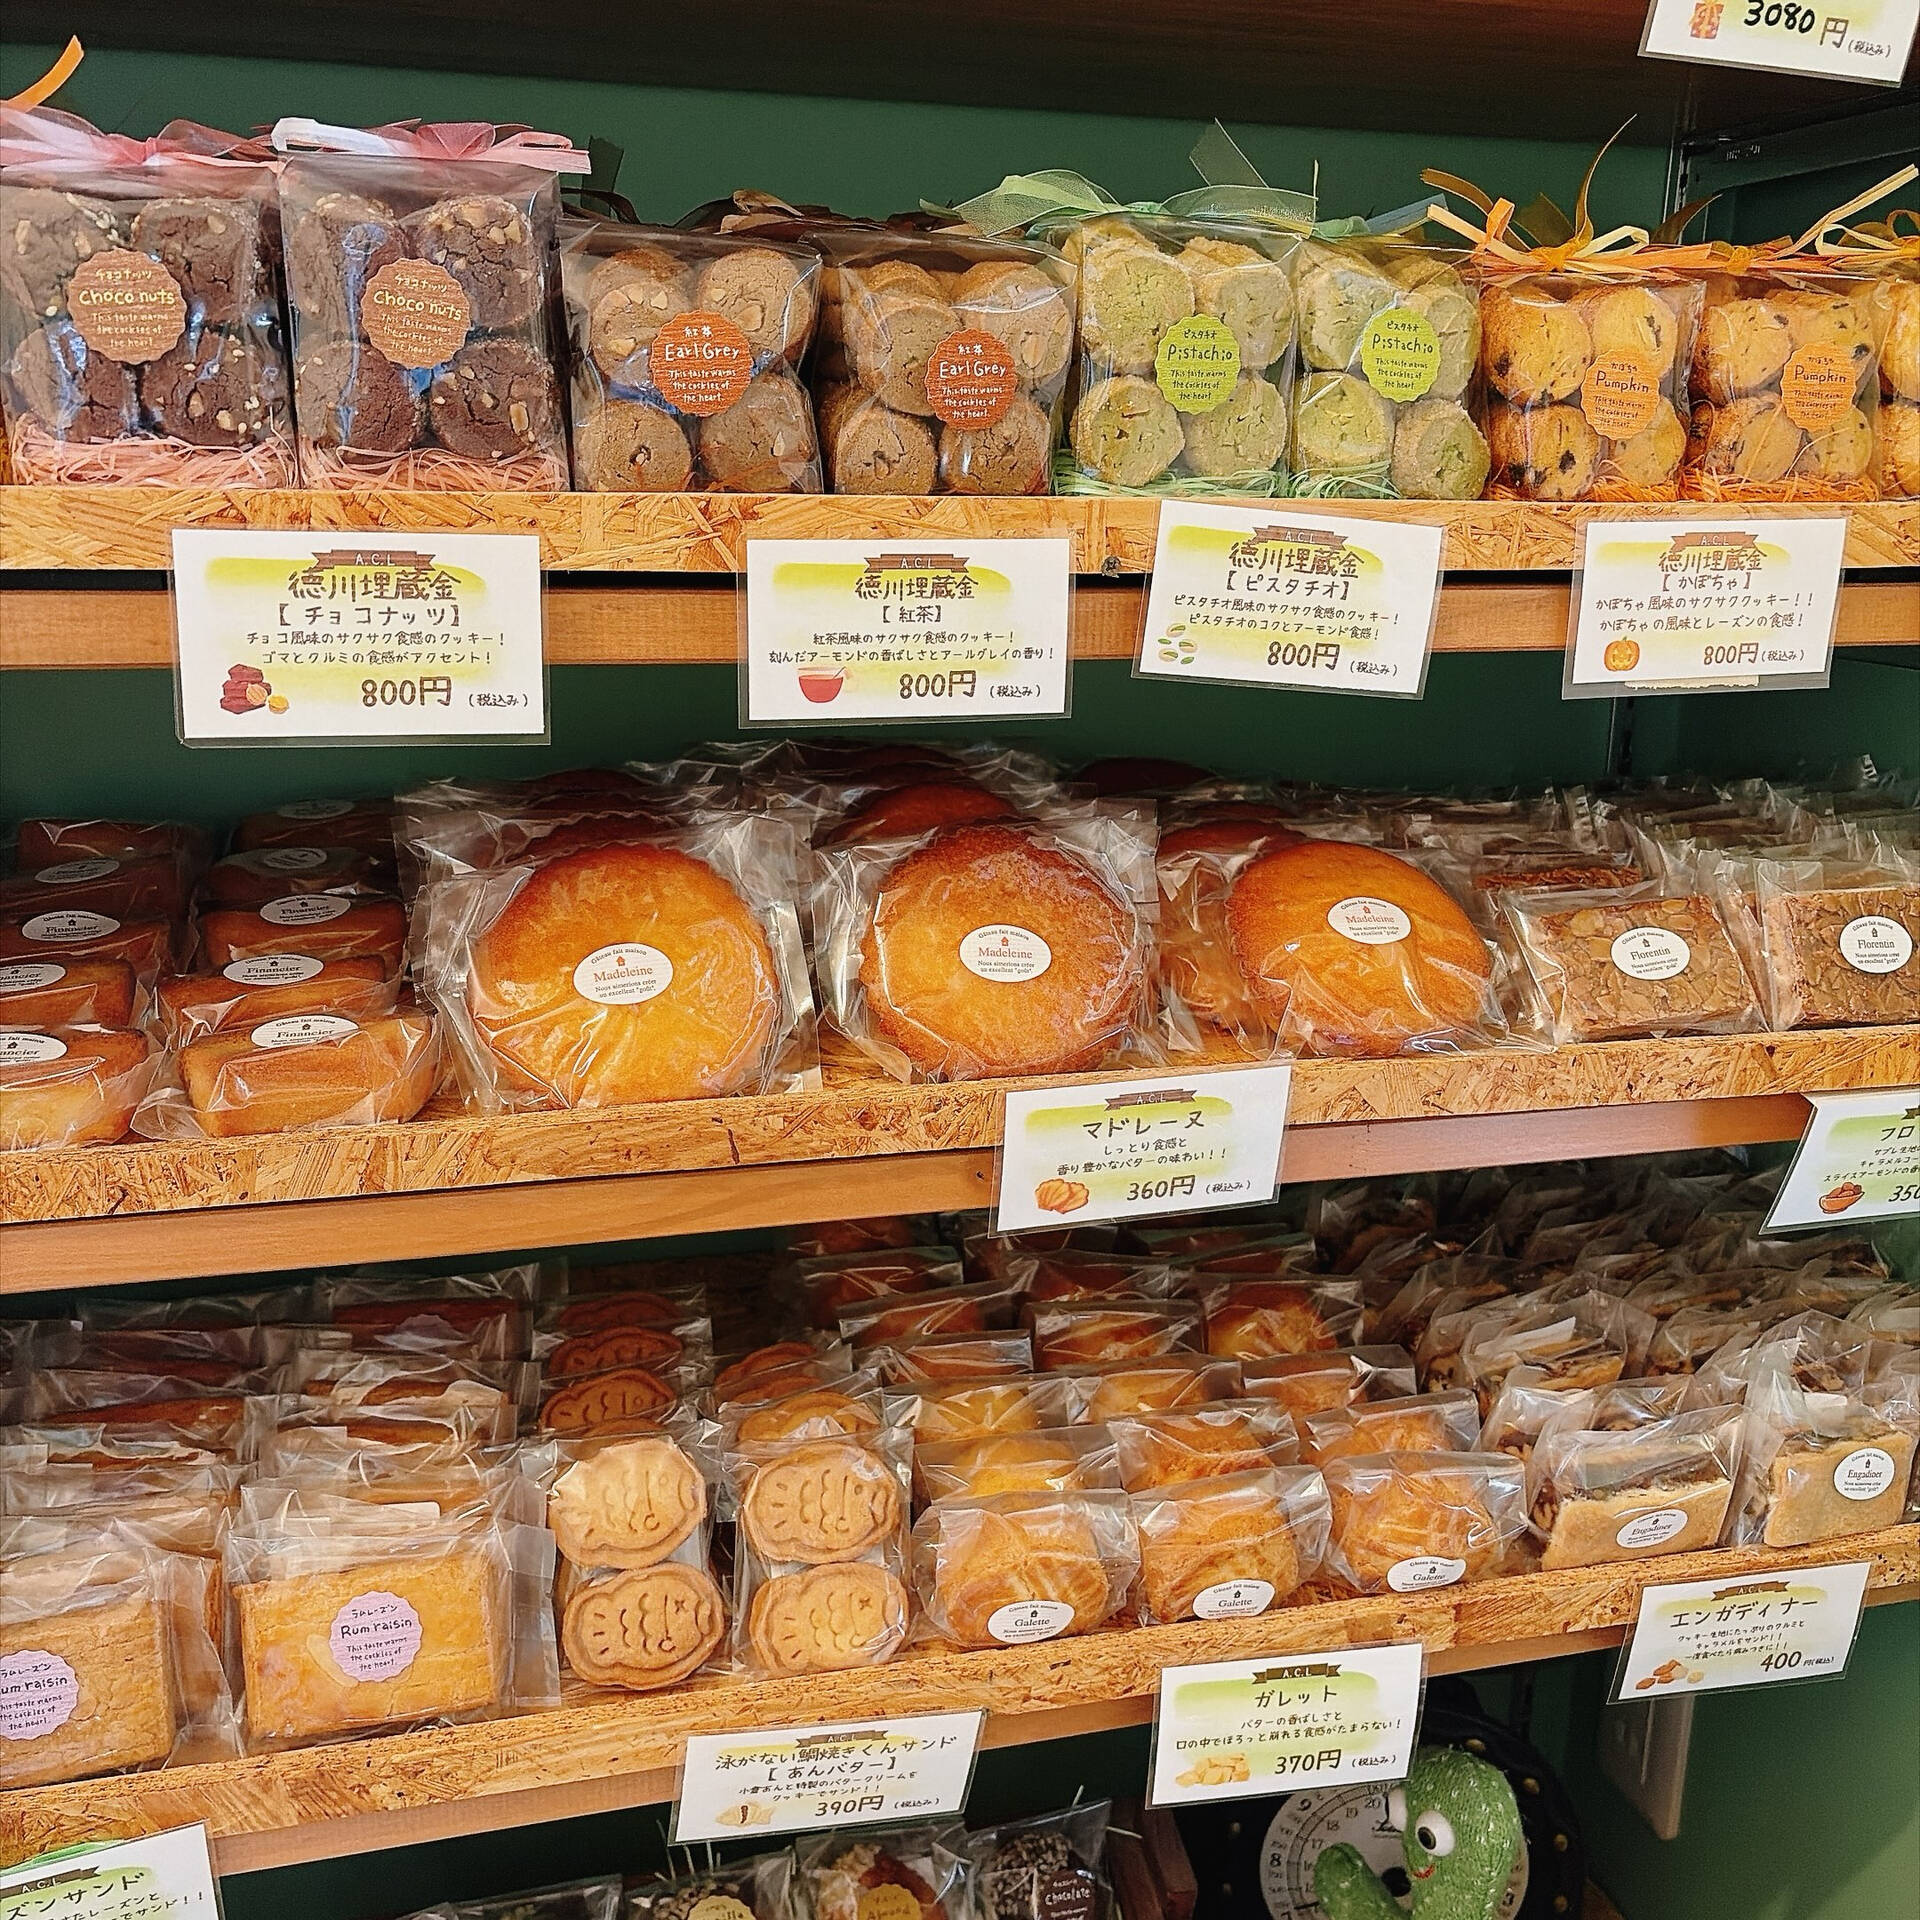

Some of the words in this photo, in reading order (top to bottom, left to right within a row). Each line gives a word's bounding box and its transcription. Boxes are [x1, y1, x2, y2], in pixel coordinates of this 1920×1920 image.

[80, 289, 134, 304] Choco
[140, 288, 175, 304] nuts
[373, 290, 424, 311] Choco
[430, 301, 461, 321] nuts
[684, 325, 713, 338] 紅茶
[1387, 321, 1419, 332] ピスタチオ
[665, 342, 699, 361] Earl
[702, 342, 739, 360] Grey
[1168, 344, 1233, 361] Pistachio
[1372, 334, 1433, 353] Pistachio
[940, 361, 970, 378] Earl
[974, 360, 1006, 377] Grey
[1794, 364, 1847, 384] Pumpkin
[1596, 370, 1649, 393] Pumpkin
[1228, 541, 1365, 579] 徳川埋蔵金
[1658, 549, 1768, 573] 徳川埋蔵金
[288, 569, 462, 603] 徳川埋蔵金
[855, 575, 979, 601] 徳川埋蔵金
[1225, 570, 1350, 600] 【ピスタチオ】
[1663, 573, 1753, 592] 【かぼちゃ】
[882, 605, 942, 624] 【紅茶】
[1174, 594, 1400, 625] ピスタチオ風味のサクサク食感のクッキー！
[1189, 612, 1380, 641] ピスタチオのコクとアーモンド食感！
[1599, 613, 1803, 632] かぼちゃの風味とレーズンの食感！
[246, 631, 506, 646] チョコ風味のサクサク食感のクッキー！
[813, 630, 1015, 645] 紅茶風味のサクサク食感のクッキー！
[261, 650, 492, 665] ゴマとクルミの食感がアクセント！
[768, 647, 1054, 663] 刻んだアーモンドの香ばしさとアールグレイの香り！
[1267, 641, 1340, 670] 800円
[1703, 642, 1759, 666] 800円
[361, 675, 451, 707] 800円
[899, 670, 977, 700] 800円
[1346, 915, 1394, 923] Madeleine
[978, 947, 1033, 959] Madeleine
[1631, 946, 1671, 960] Florentin
[1858, 940, 1895, 949] Florentin
[593, 966, 653, 983] Madeleine
[277, 1028, 336, 1038] Financier
[1082, 1110, 1205, 1140] マドレーヌ
[1104, 1137, 1187, 1156] しっとり食感と
[1056, 1148, 1227, 1176] 香り豊かなバターの味わい！！
[1824, 1165, 1920, 1182] スライスアーモンドの香
[1127, 1174, 1196, 1201] 360円
[1848, 1470, 1882, 1480] Engadiner
[352, 1604, 398, 1618] ラムレーズン
[1219, 1599, 1252, 1607] Galette
[1670, 1597, 1819, 1628] エンガディナー
[341, 1625, 370, 1639] Rum
[373, 1619, 412, 1632] raisin
[1015, 1619, 1050, 1627] Galette
[1678, 1620, 1805, 1642] クッキー生地にたっぷりのクルミと
[0, 1685, 20, 1695] um
[25, 1677, 67, 1690] raisin
[1255, 1685, 1337, 1708] ガレット
[1241, 1711, 1342, 1729] バターの香ばしさと
[1176, 1719, 1401, 1750] 口の中でほろっと崩れる食感がたまらない！
[716, 1735, 957, 1771] 泳がない鯛焼きくんサンド
[1274, 1749, 1341, 1775] 370円
[815, 1794, 884, 1817] 390円
[1270, 1852, 1282, 1867] 8
